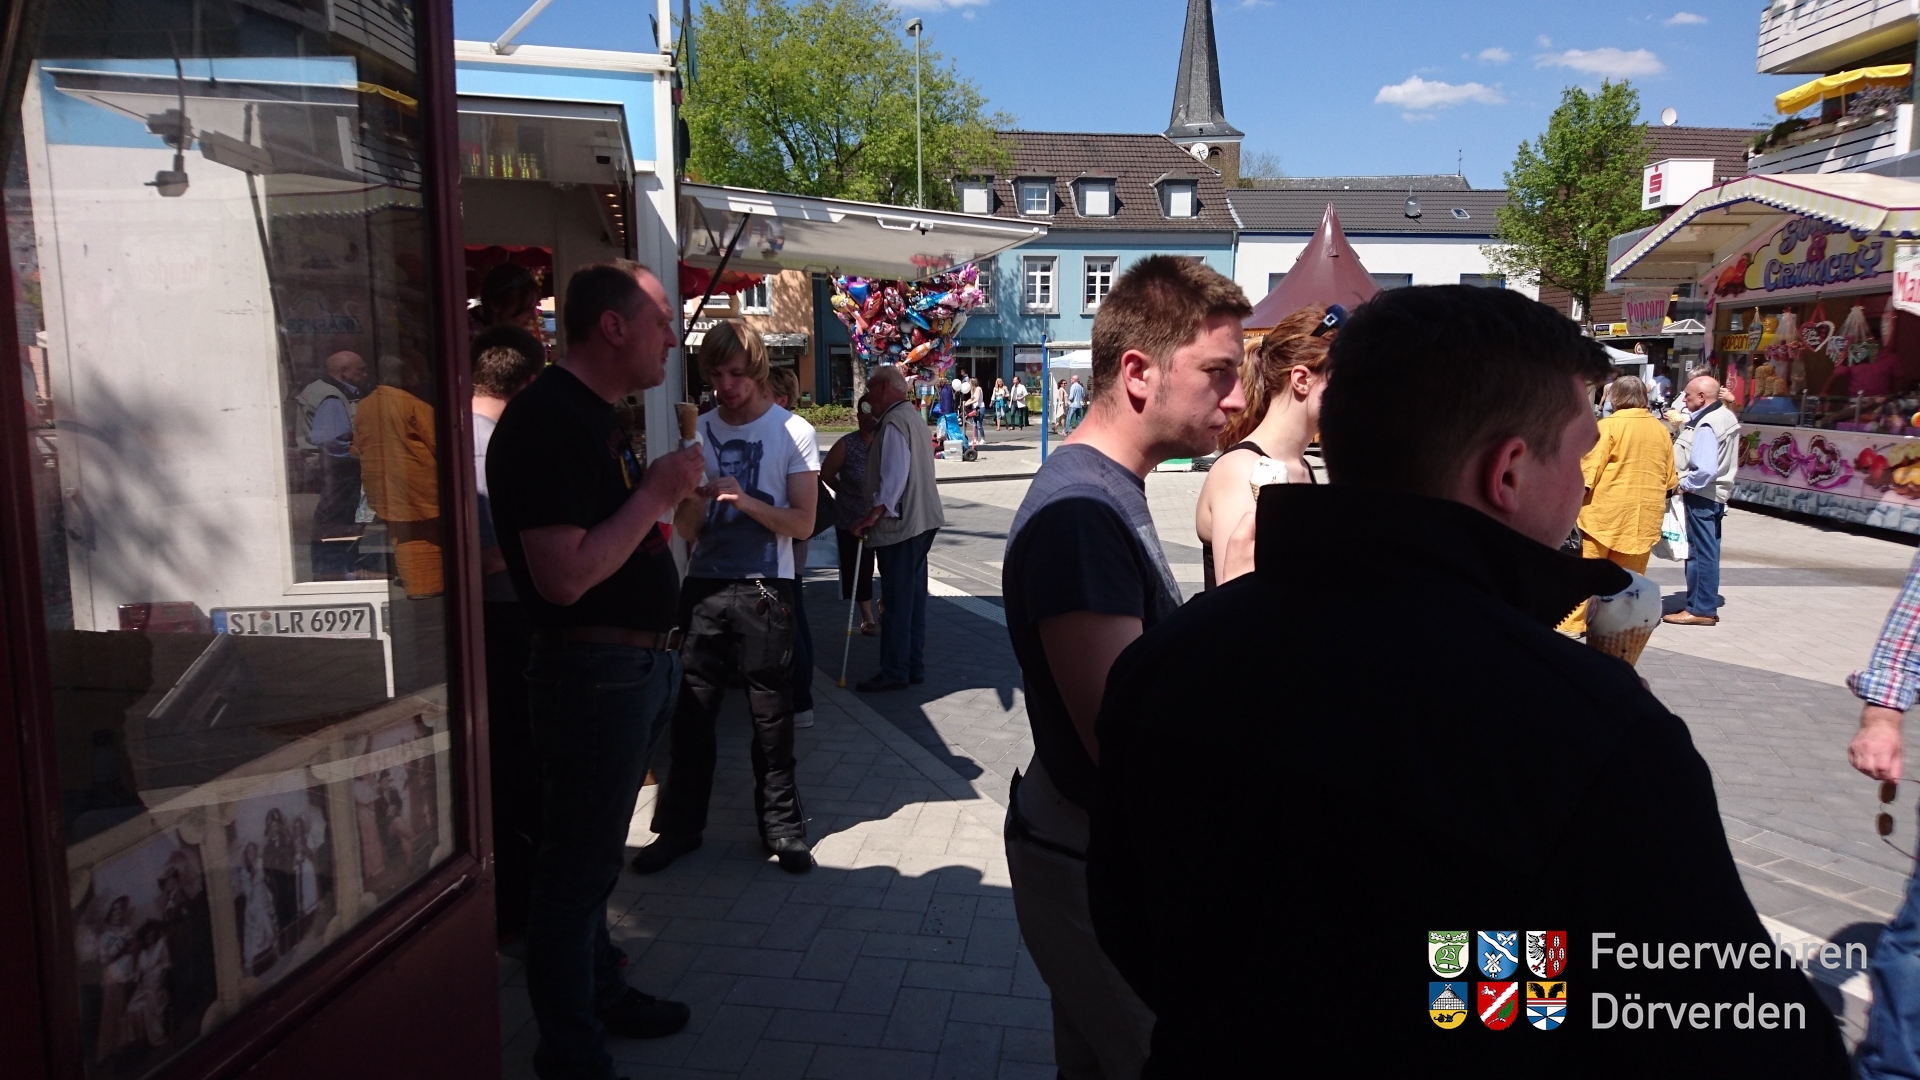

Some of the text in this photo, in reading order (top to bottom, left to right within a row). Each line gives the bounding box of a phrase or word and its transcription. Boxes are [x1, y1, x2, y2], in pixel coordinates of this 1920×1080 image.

[230, 613, 259, 635] SI
[275, 611, 304, 634] LR
[310, 609, 365, 632] 6997
